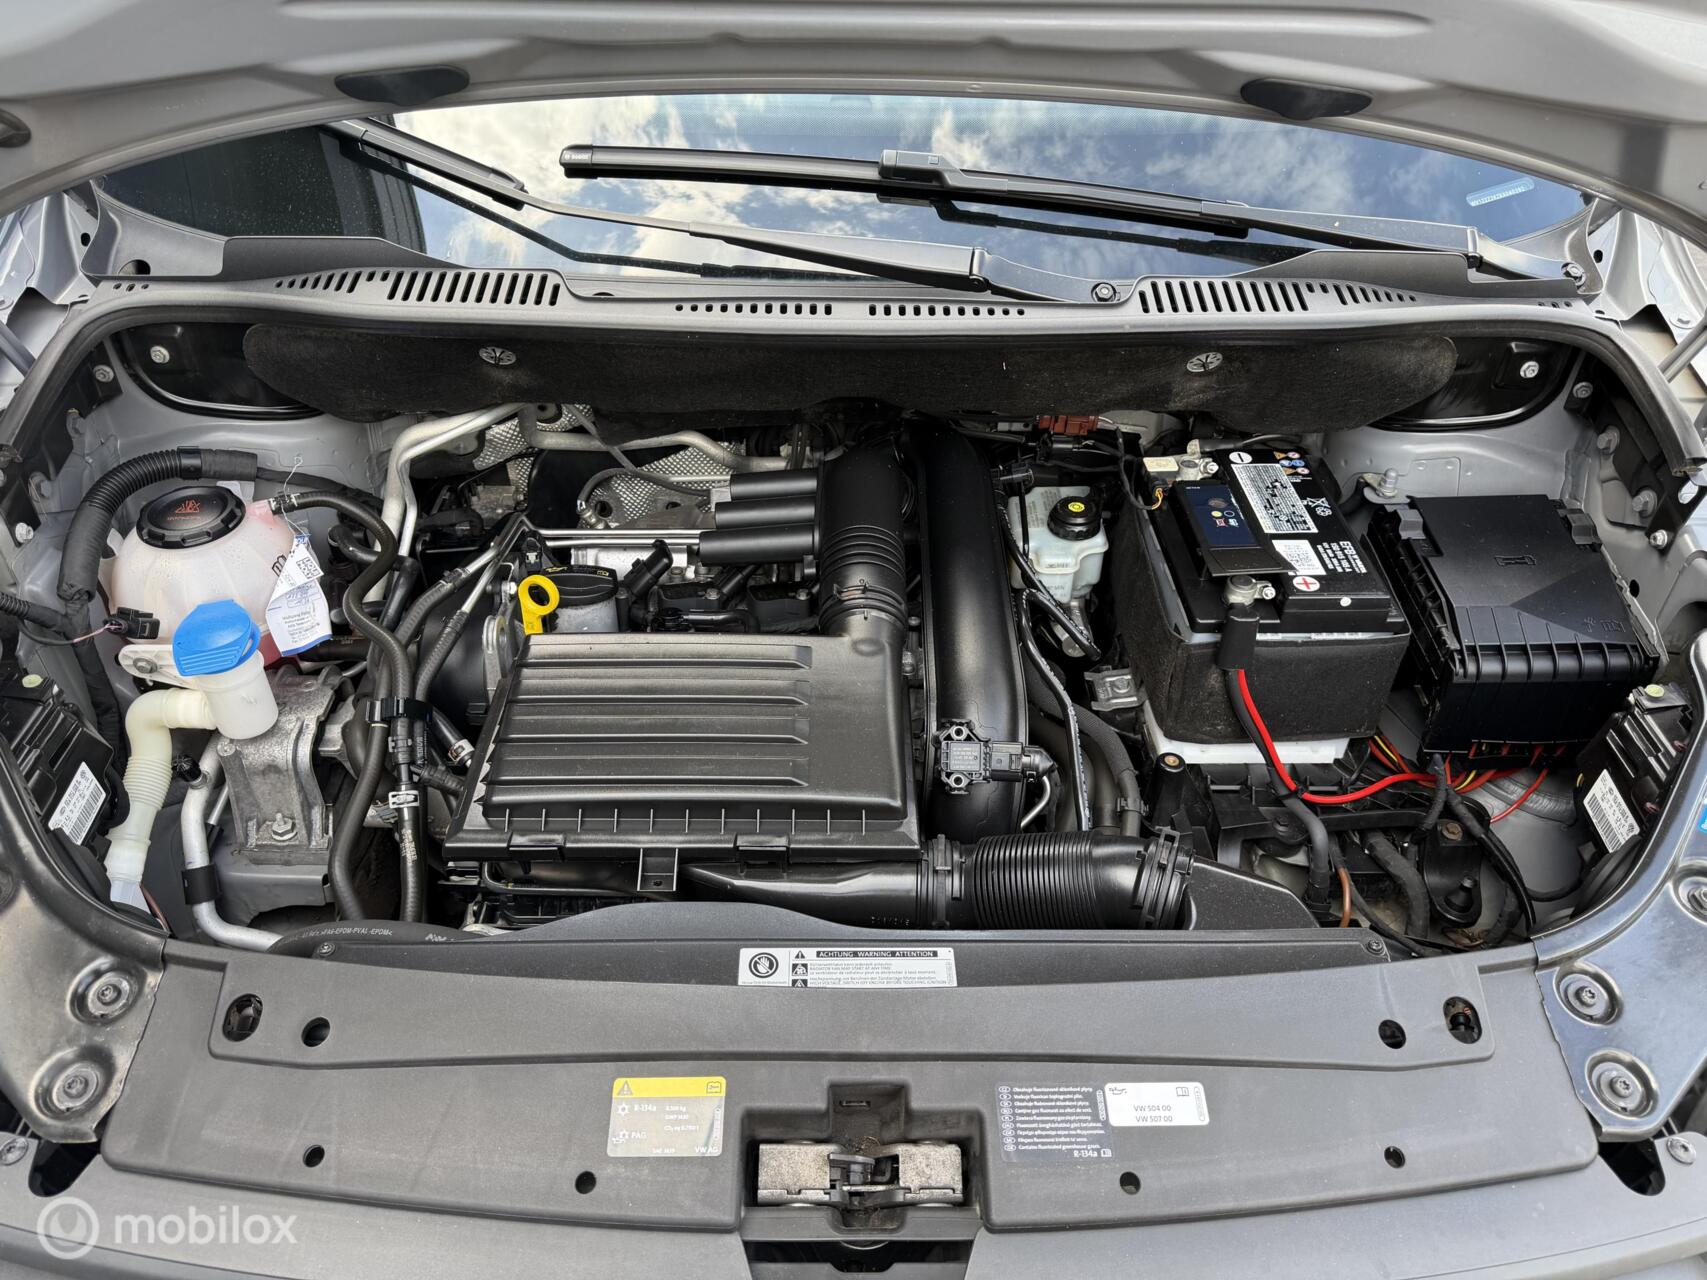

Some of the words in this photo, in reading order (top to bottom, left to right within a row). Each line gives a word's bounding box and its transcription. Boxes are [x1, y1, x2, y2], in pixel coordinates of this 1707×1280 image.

[1339, 541, 1356, 555] EFB
[1133, 1104, 1146, 1112] VW
[1148, 1104, 1160, 1112] 504
[1162, 1104, 1172, 1112] 00
